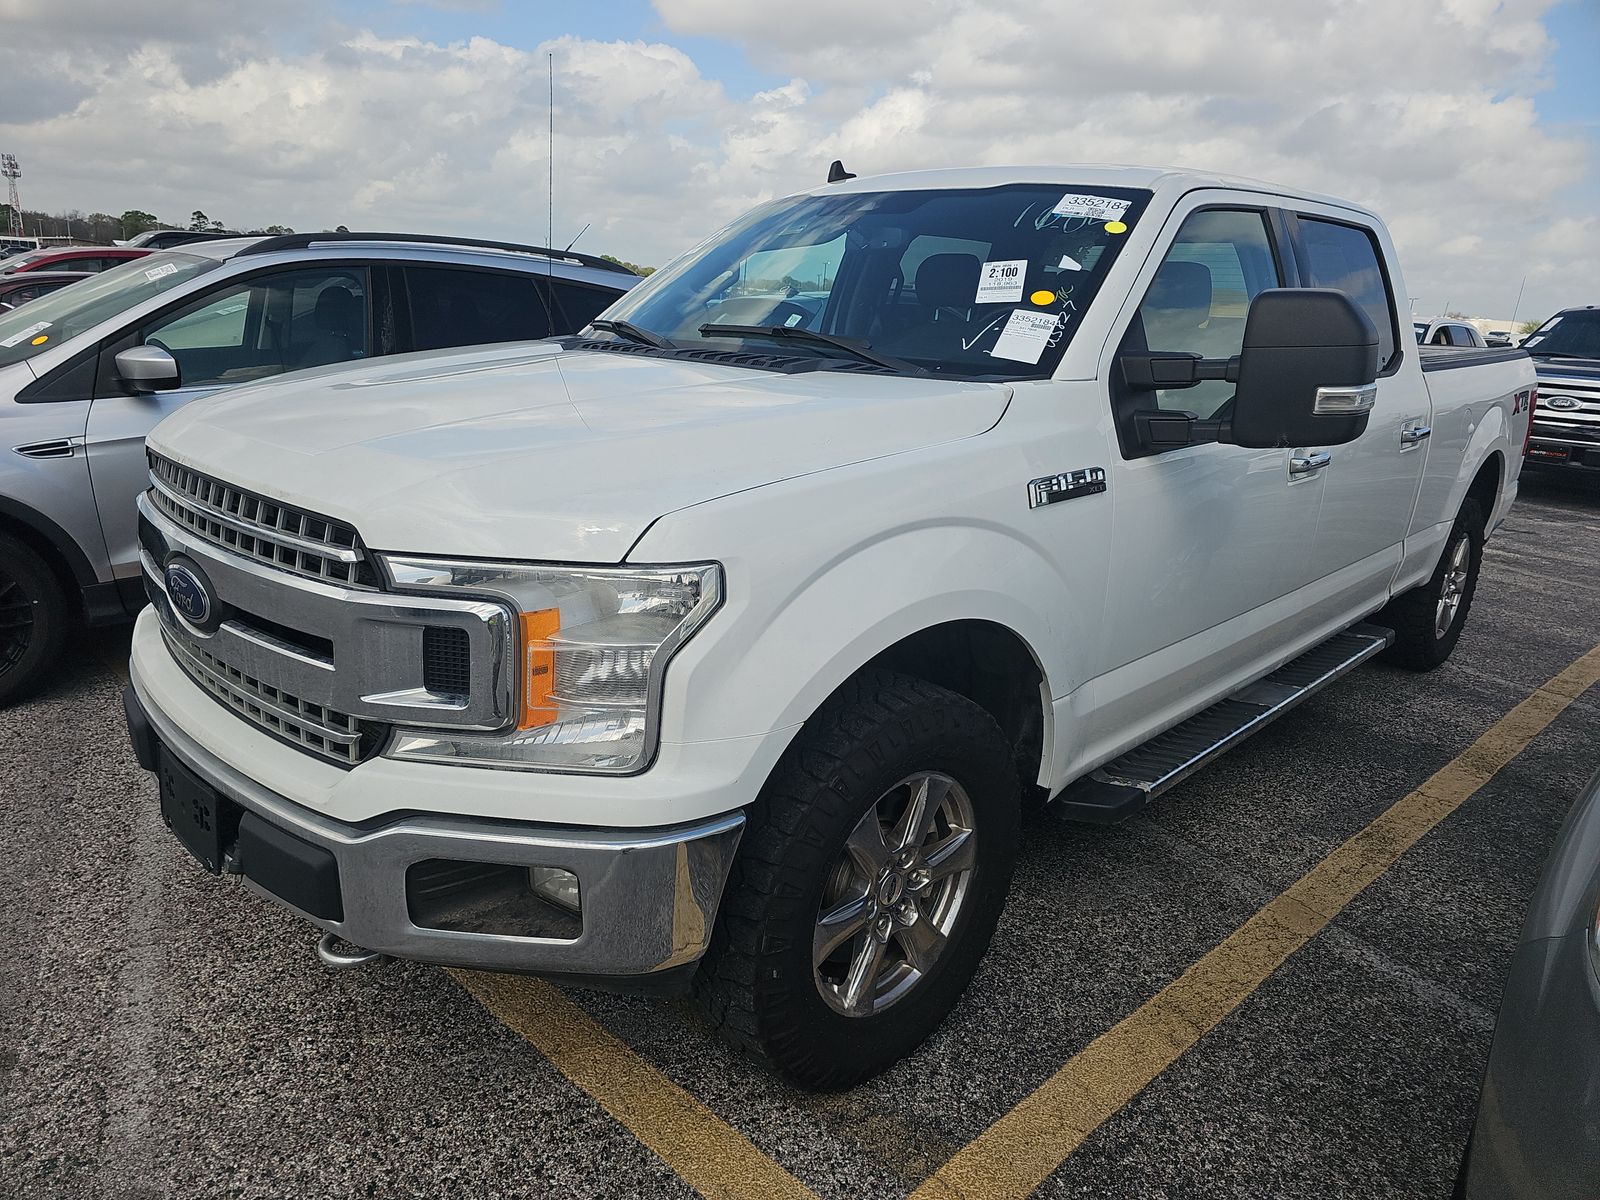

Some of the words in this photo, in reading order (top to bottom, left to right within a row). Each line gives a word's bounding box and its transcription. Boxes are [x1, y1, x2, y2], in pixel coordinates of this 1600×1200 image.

[1068, 196, 1130, 212] 3352184
[989, 267, 1018, 278] 2:100
[1012, 314, 1056, 326] 3352184
[1553, 399, 1573, 407] Ford
[1089, 484, 1104, 493] XLT
[170, 575, 196, 613] Ford
